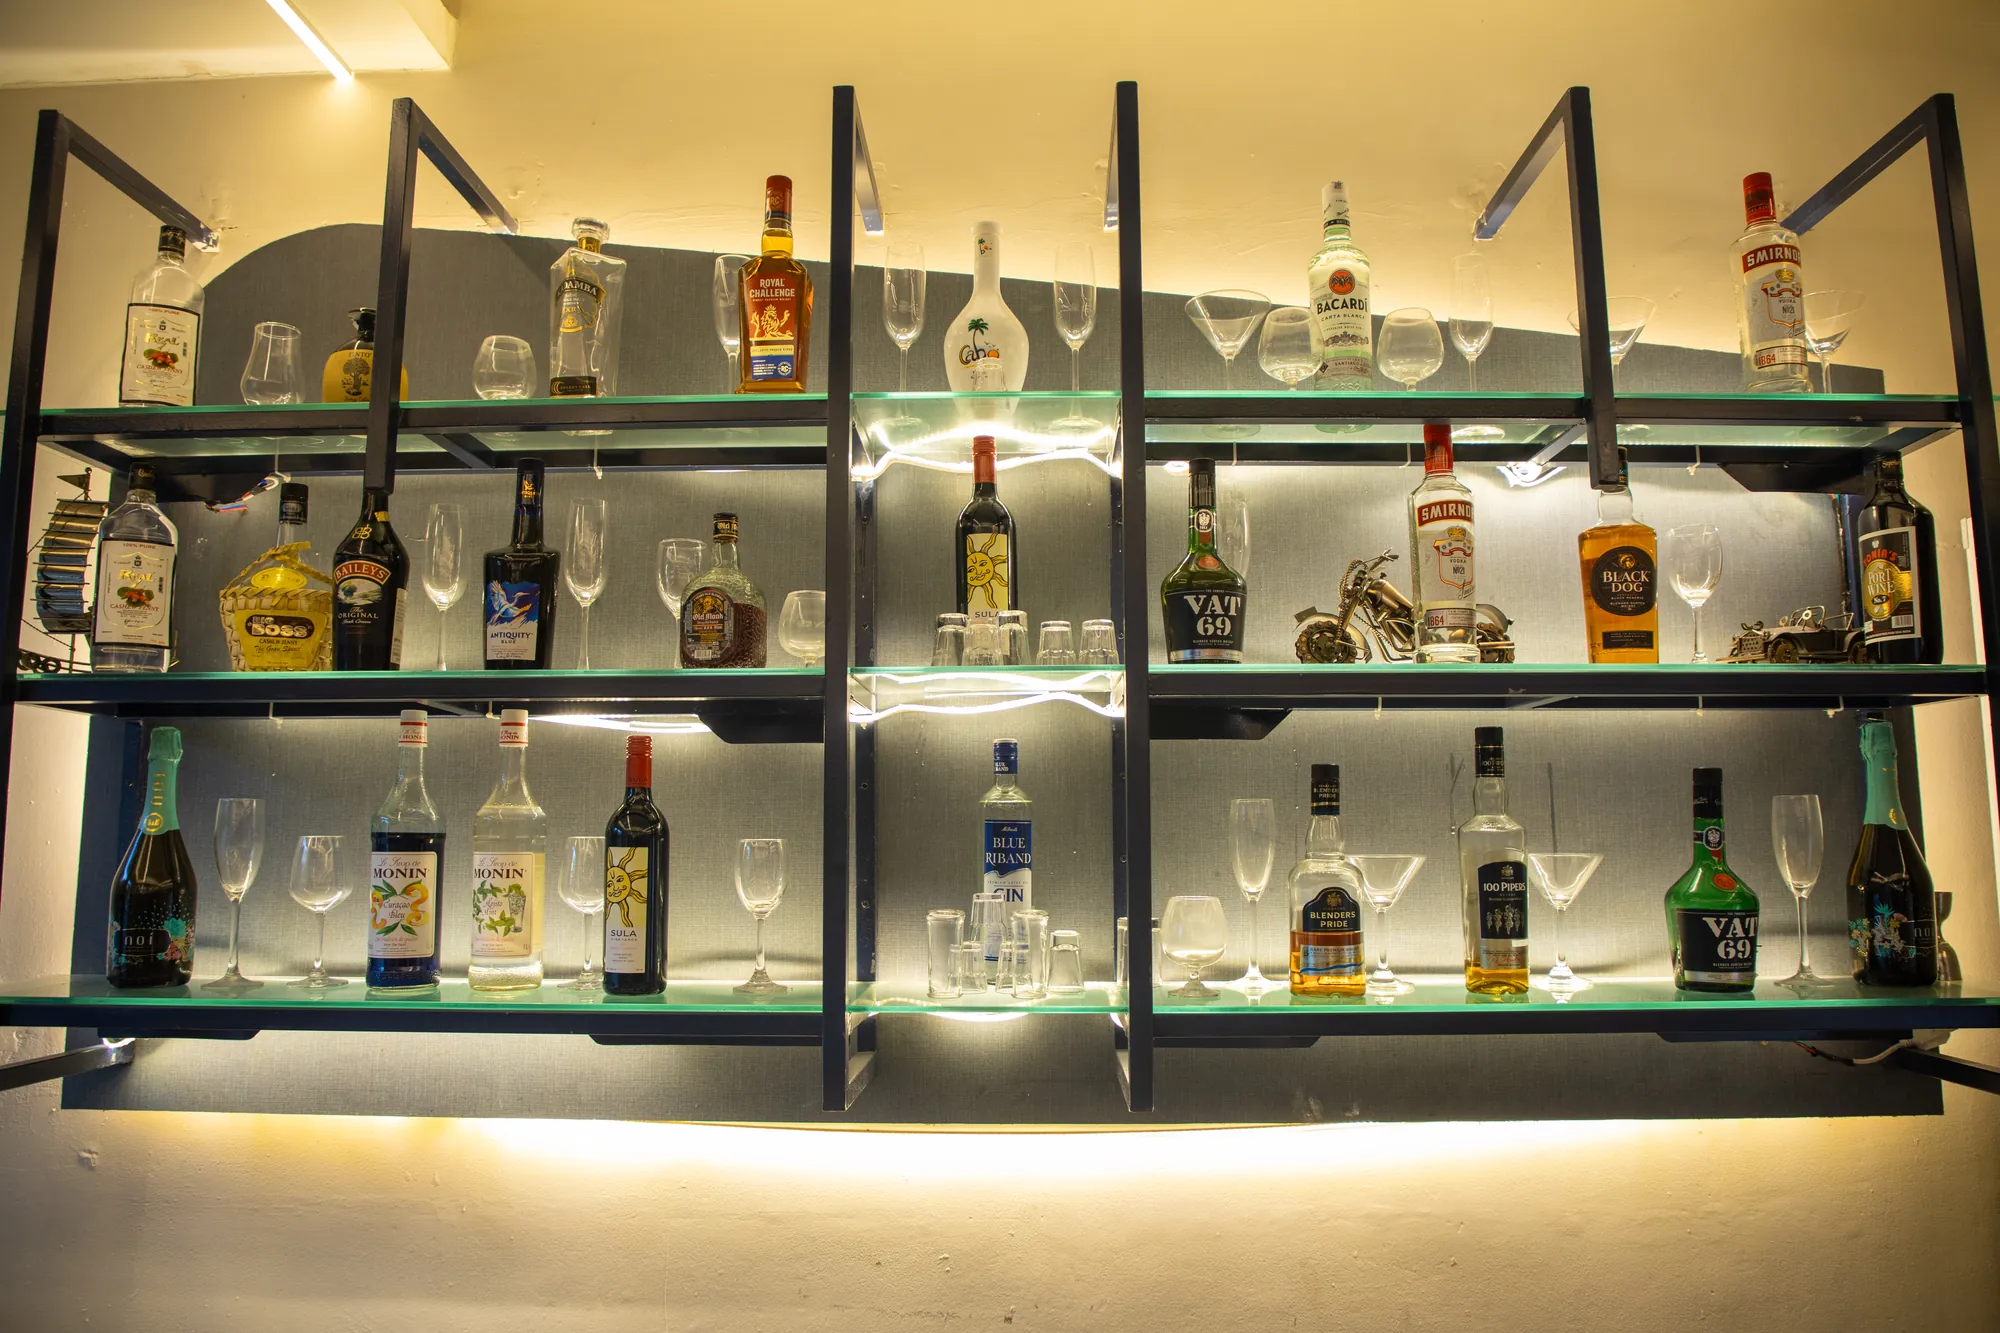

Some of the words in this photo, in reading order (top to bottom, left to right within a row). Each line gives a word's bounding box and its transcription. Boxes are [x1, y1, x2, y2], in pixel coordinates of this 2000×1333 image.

[557, 281, 597, 296] DAMBA
[760, 278, 785, 289] ROYAL
[749, 288, 795, 298] CHALLENGE
[1321, 313, 1341, 322] CARTA
[959, 344, 1000, 366] Cabo
[1758, 353, 1776, 366] 1864
[1421, 503, 1475, 521] SMIRNO
[336, 564, 386, 579] BAILEYS
[1602, 570, 1650, 583] BLACK
[1868, 568, 1892, 585] PORT
[1611, 582, 1643, 593] DOG
[1867, 580, 1896, 597] WINE
[1183, 594, 1241, 616] VAT
[692, 613, 705, 621] Old
[705, 613, 724, 621] Monk
[1427, 615, 1444, 629] 1864
[251, 623, 308, 638] BOSS
[1196, 616, 1232, 636] 69
[490, 631, 531, 640] ANTIQUITY
[993, 837, 1026, 849] BLUE
[985, 852, 1031, 867] RIBAND
[373, 868, 427, 879] MONIN
[474, 868, 524, 879] MONIN
[1483, 882, 1500, 892] 100
[1501, 882, 1526, 892] PIPERS
[383, 898, 410, 910] Curaçao
[388, 908, 405, 919] Bleu
[1310, 911, 1356, 919] BLENDERS
[1320, 920, 1348, 928] PRIDE
[1702, 916, 1758, 938] VAT
[610, 929, 637, 938] SULA
[1717, 939, 1751, 960] 69
